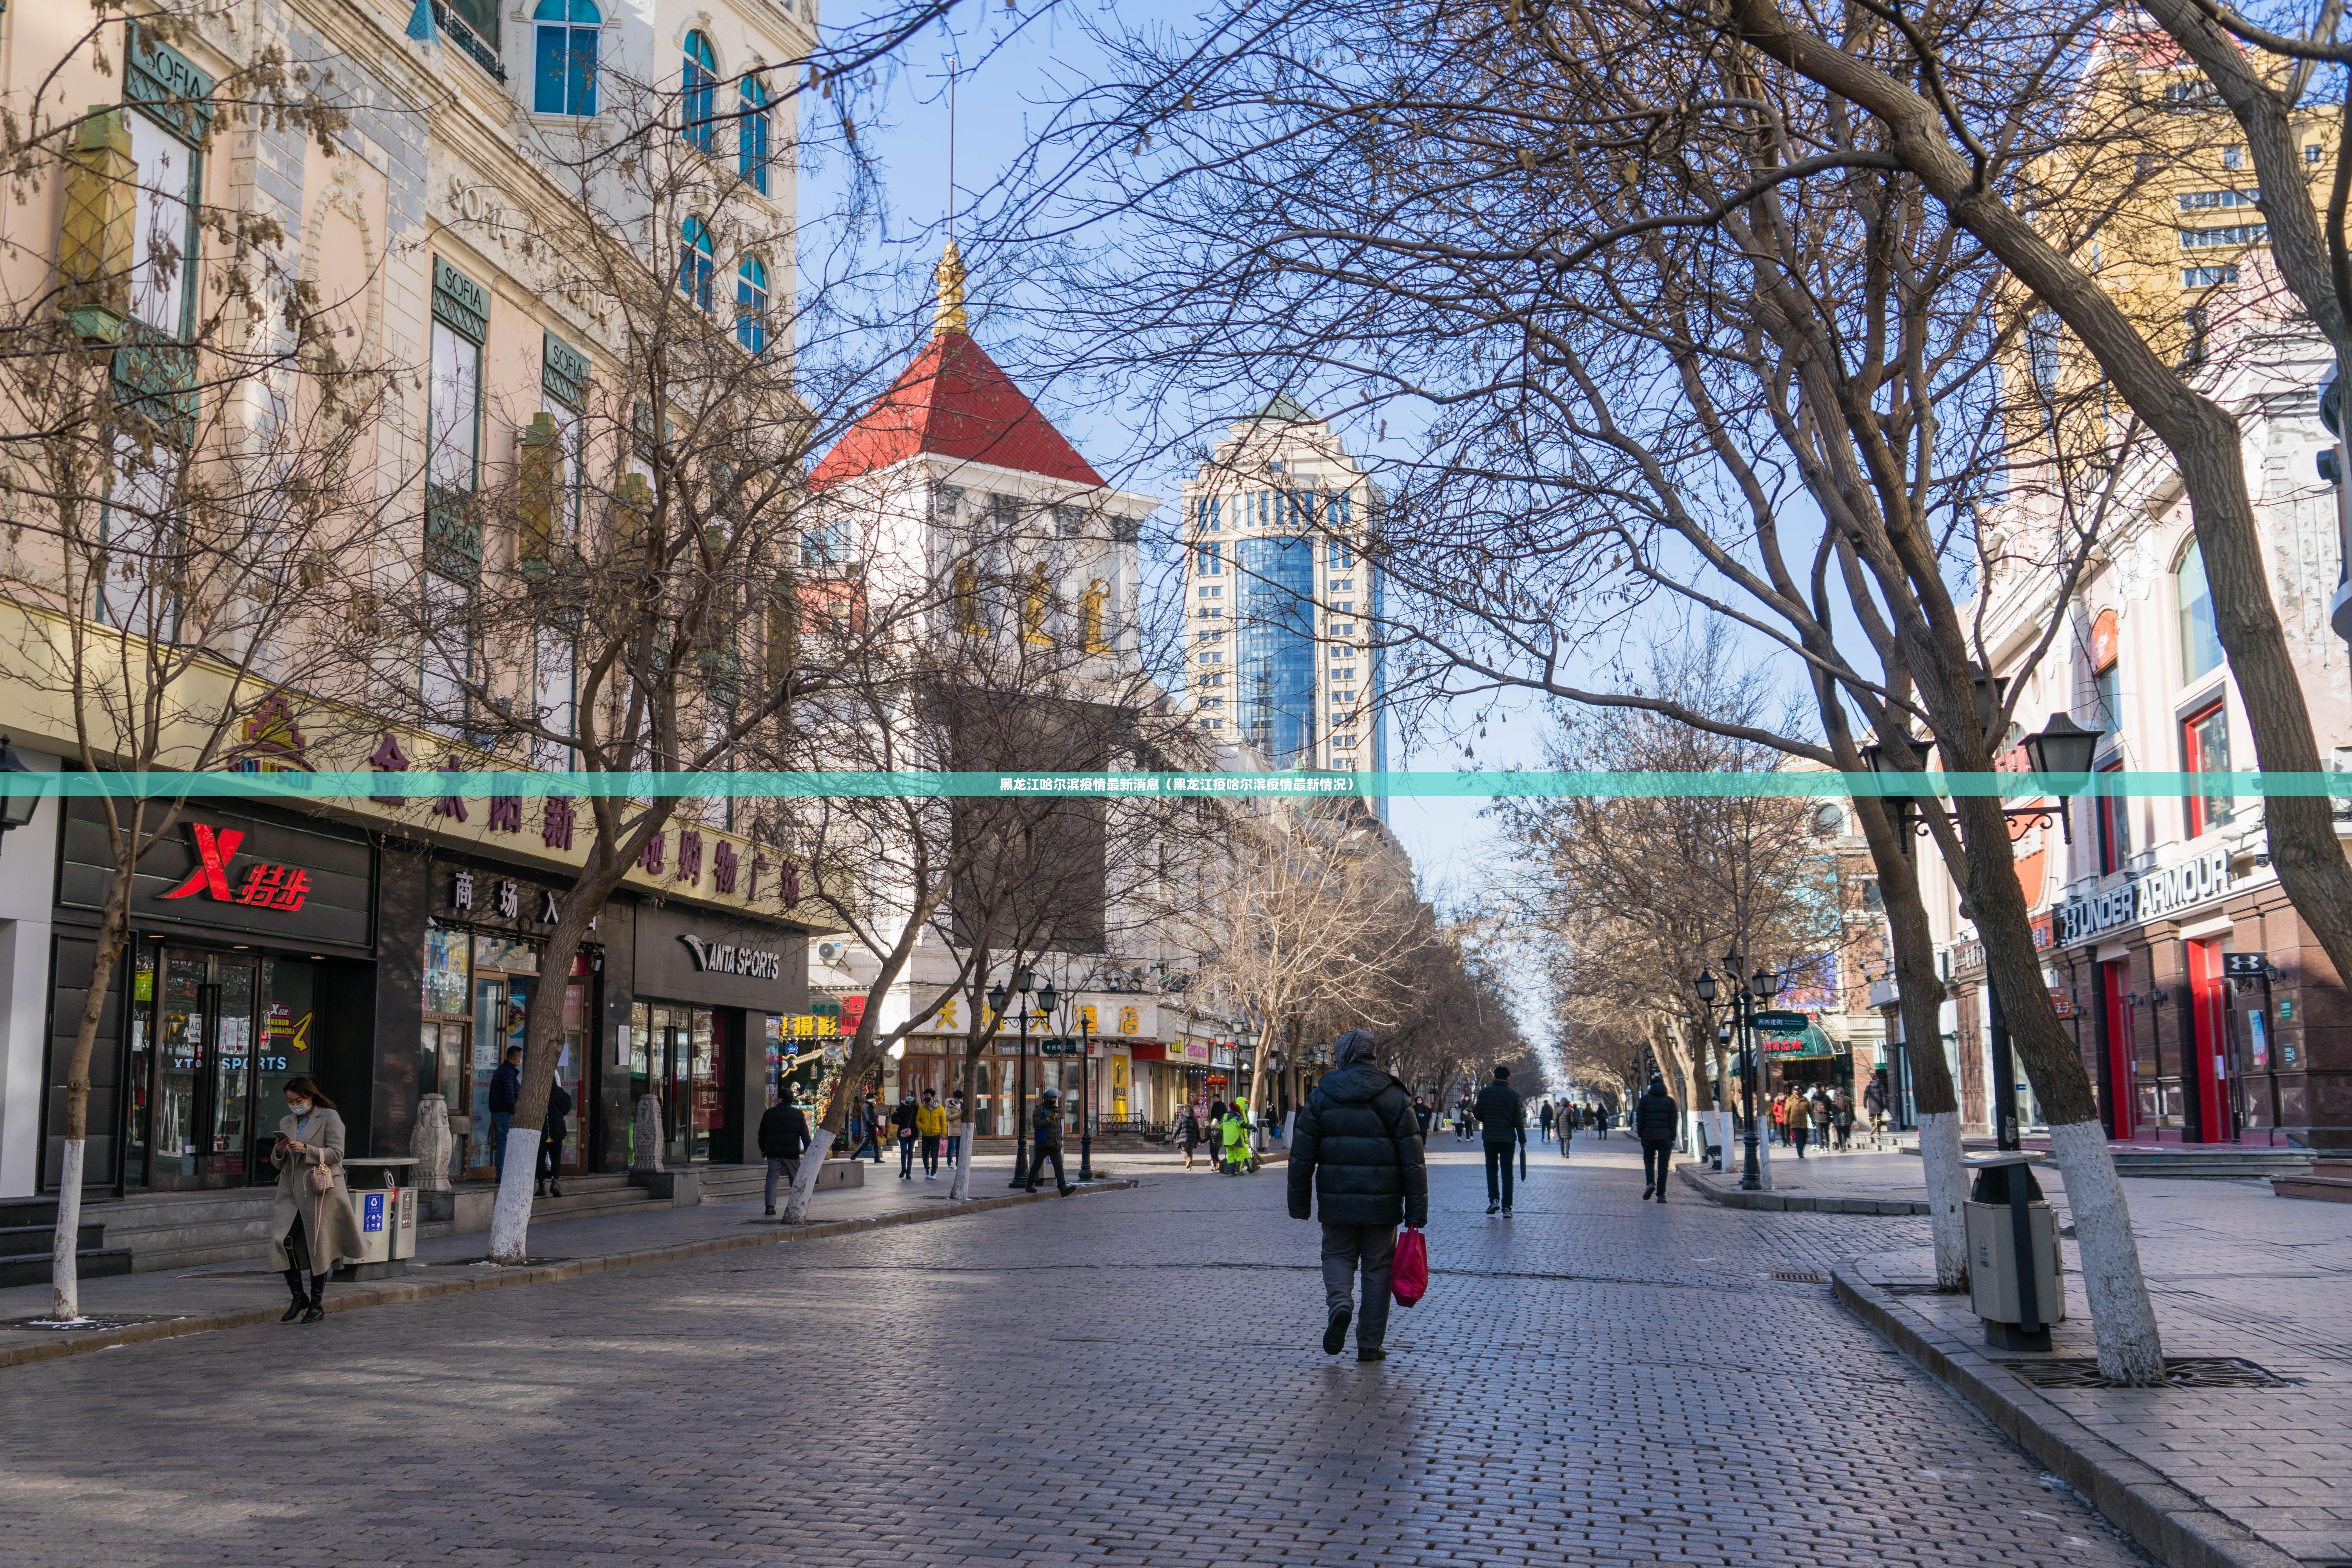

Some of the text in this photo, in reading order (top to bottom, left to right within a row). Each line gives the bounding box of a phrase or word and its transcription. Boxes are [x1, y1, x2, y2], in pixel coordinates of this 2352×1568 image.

[450, 174, 509, 249] SOFIA
[445, 267, 482, 312] SOFIA
[553, 345, 584, 385] SOFIA
[370, 734, 800, 909] 金太阳新地购物广场
[456, 871, 596, 930] 商场入
[2079, 848, 2230, 935] UNDER ARMOUR
[708, 943, 780, 980] ANTA SPORTS
